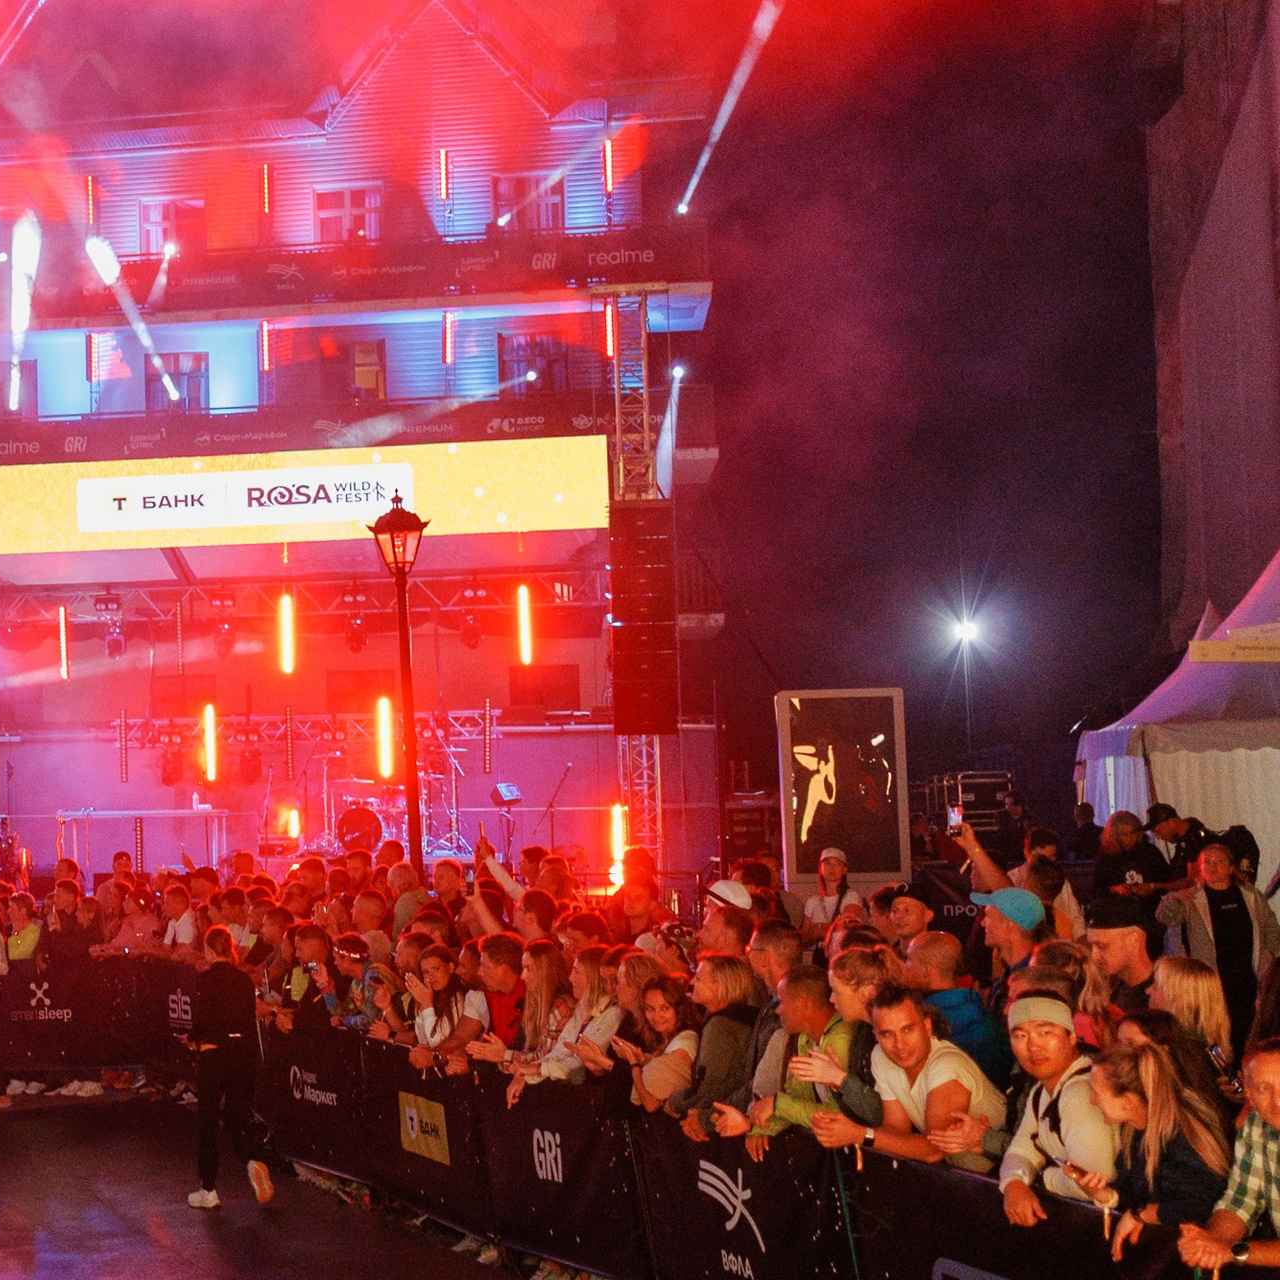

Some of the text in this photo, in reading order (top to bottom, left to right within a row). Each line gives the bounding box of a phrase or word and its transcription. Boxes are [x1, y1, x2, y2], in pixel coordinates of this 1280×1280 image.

[589, 249, 654, 266] realme
[182, 275, 235, 286] PREMIUM
[399, 424, 453, 434] PREMIUM
[65, 436, 88, 452] GRi
[215, 432, 288, 443] Спорт-Марафон
[334, 481, 371, 492] WILD
[142, 494, 205, 509] БАНК
[247, 484, 332, 507] ROSA
[336, 492, 371, 503] FEST
[10, 1007, 72, 1022] smartsleep
[303, 1084, 338, 1106] Маркет
[420, 1118, 441, 1140] БАНК
[532, 1128, 563, 1183] GRi
[721, 1249, 755, 1280] ВФЛА
